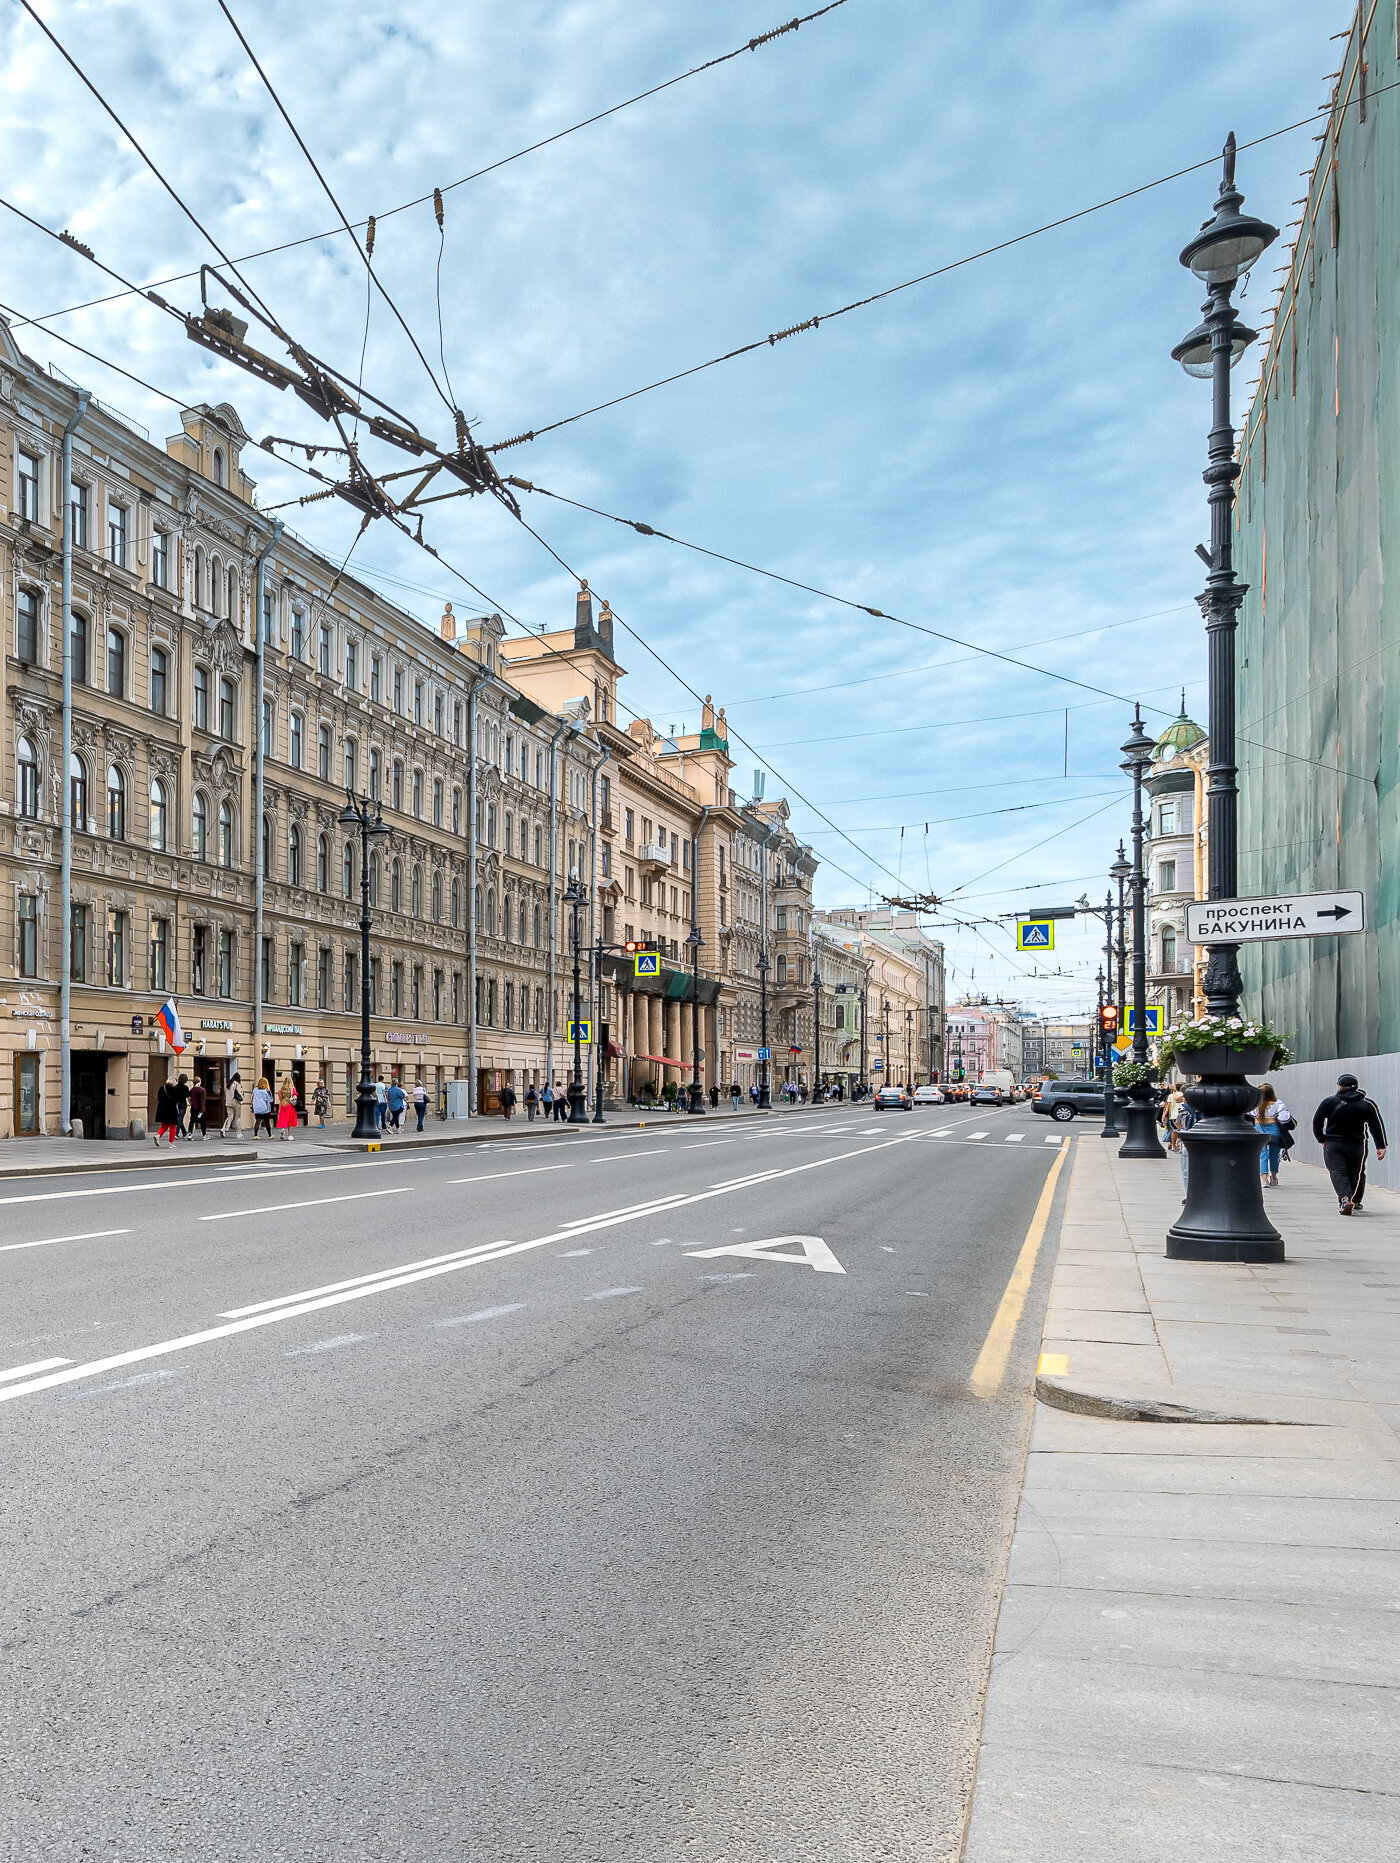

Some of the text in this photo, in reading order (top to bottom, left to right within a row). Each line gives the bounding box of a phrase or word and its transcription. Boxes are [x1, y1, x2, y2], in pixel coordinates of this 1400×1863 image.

[1206, 903, 1293, 920] проспект
[1198, 916, 1306, 935] БАКУНИНА
[637, 942, 646, 950] 21
[1103, 1020, 1116, 1029] 21
